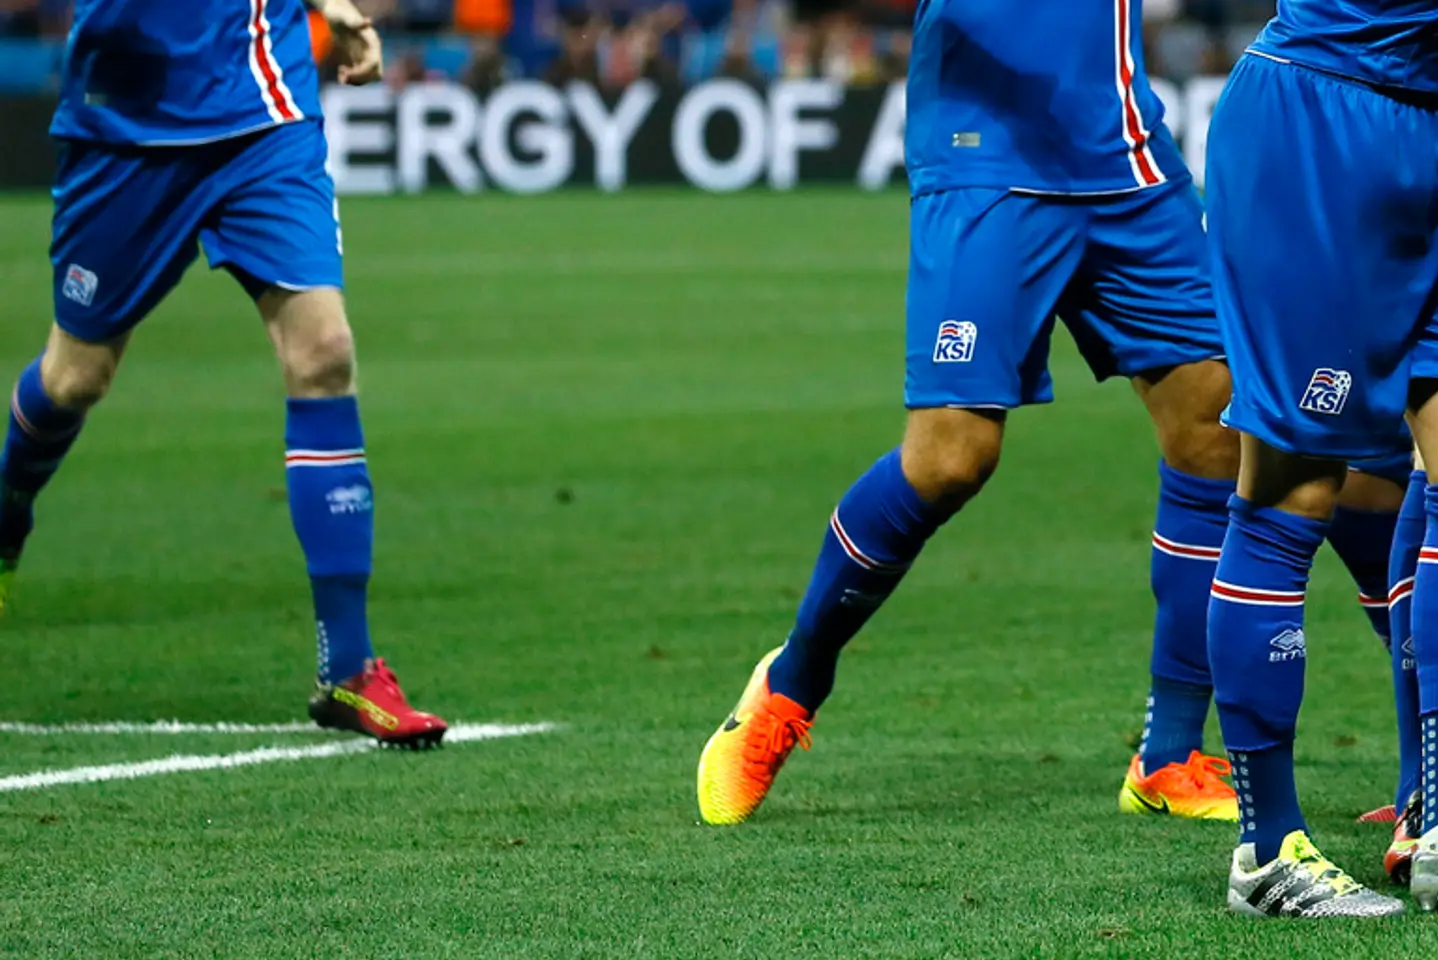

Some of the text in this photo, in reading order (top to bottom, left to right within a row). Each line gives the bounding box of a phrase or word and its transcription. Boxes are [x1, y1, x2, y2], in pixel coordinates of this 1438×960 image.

[673, 78, 845, 193] OF
[935, 342, 971, 360] KSI
[1302, 389, 1345, 412] KSI
